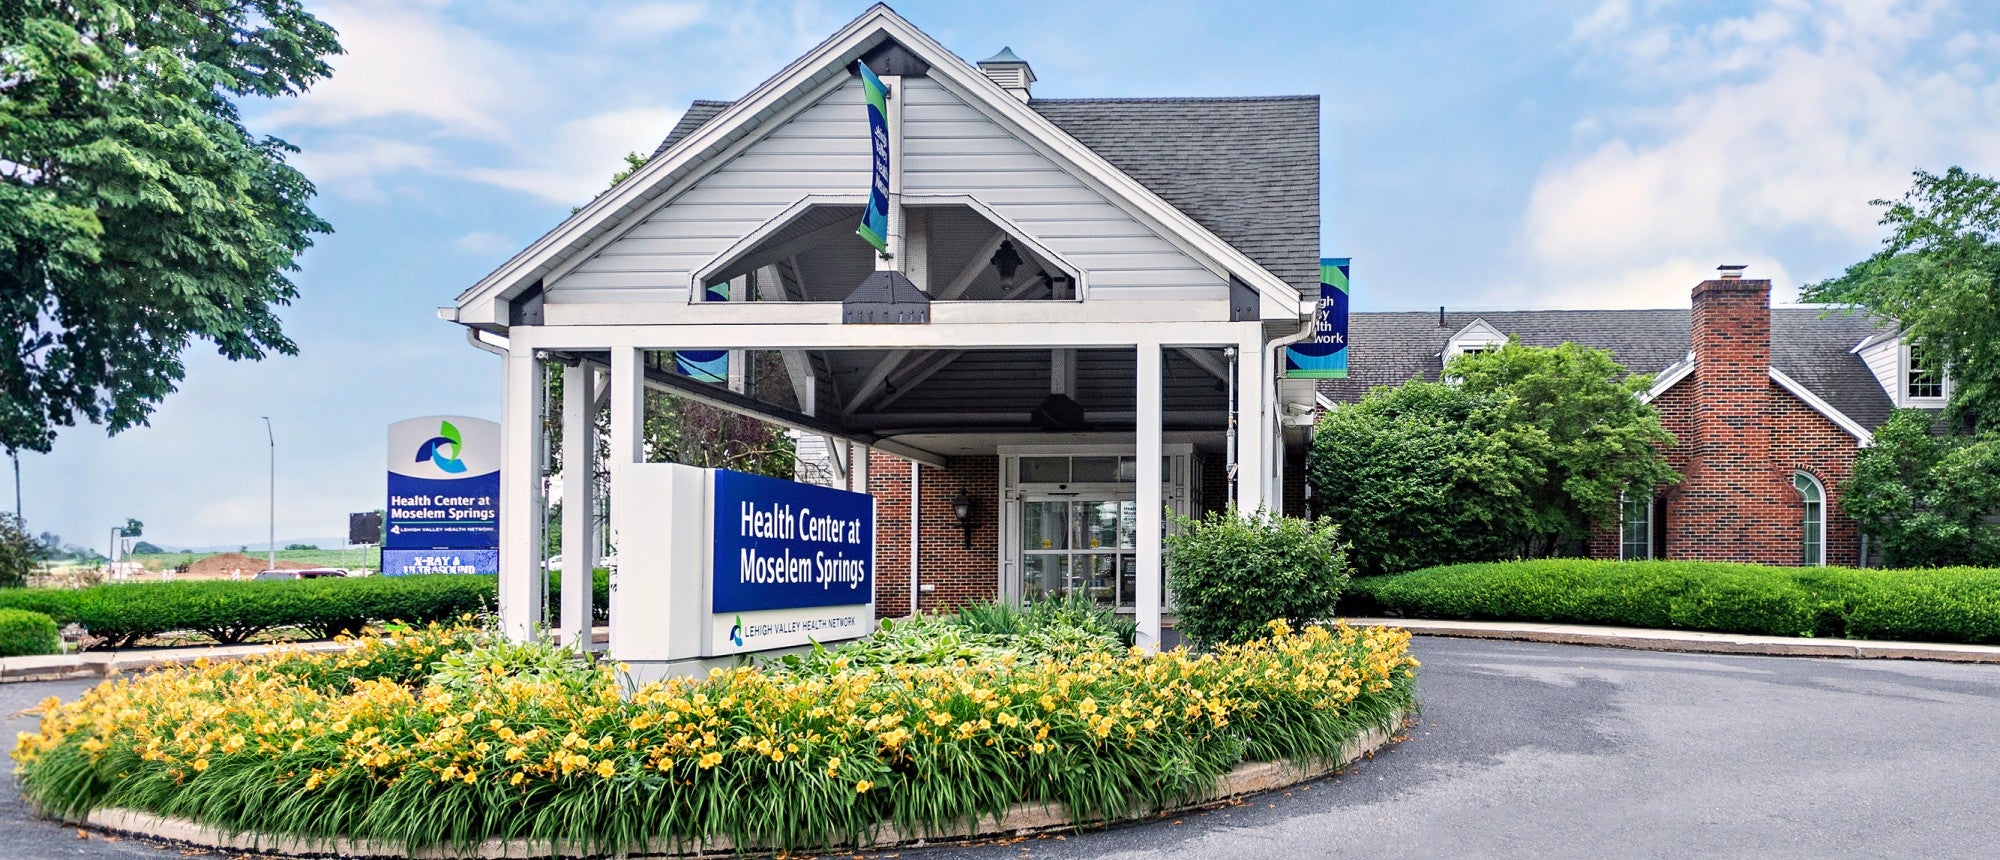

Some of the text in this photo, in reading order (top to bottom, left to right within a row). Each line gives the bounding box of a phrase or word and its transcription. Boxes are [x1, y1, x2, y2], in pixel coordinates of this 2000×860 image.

[391, 495, 490, 506] Health Center at
[391, 508, 495, 520] Moselem Springs
[741, 500, 861, 545] Health Center at
[414, 556, 450, 567] X-RAY
[740, 548, 865, 590] Moselem Springs
[744, 616, 856, 638] LEHIGH VALLEY HEALTH NETWORK
